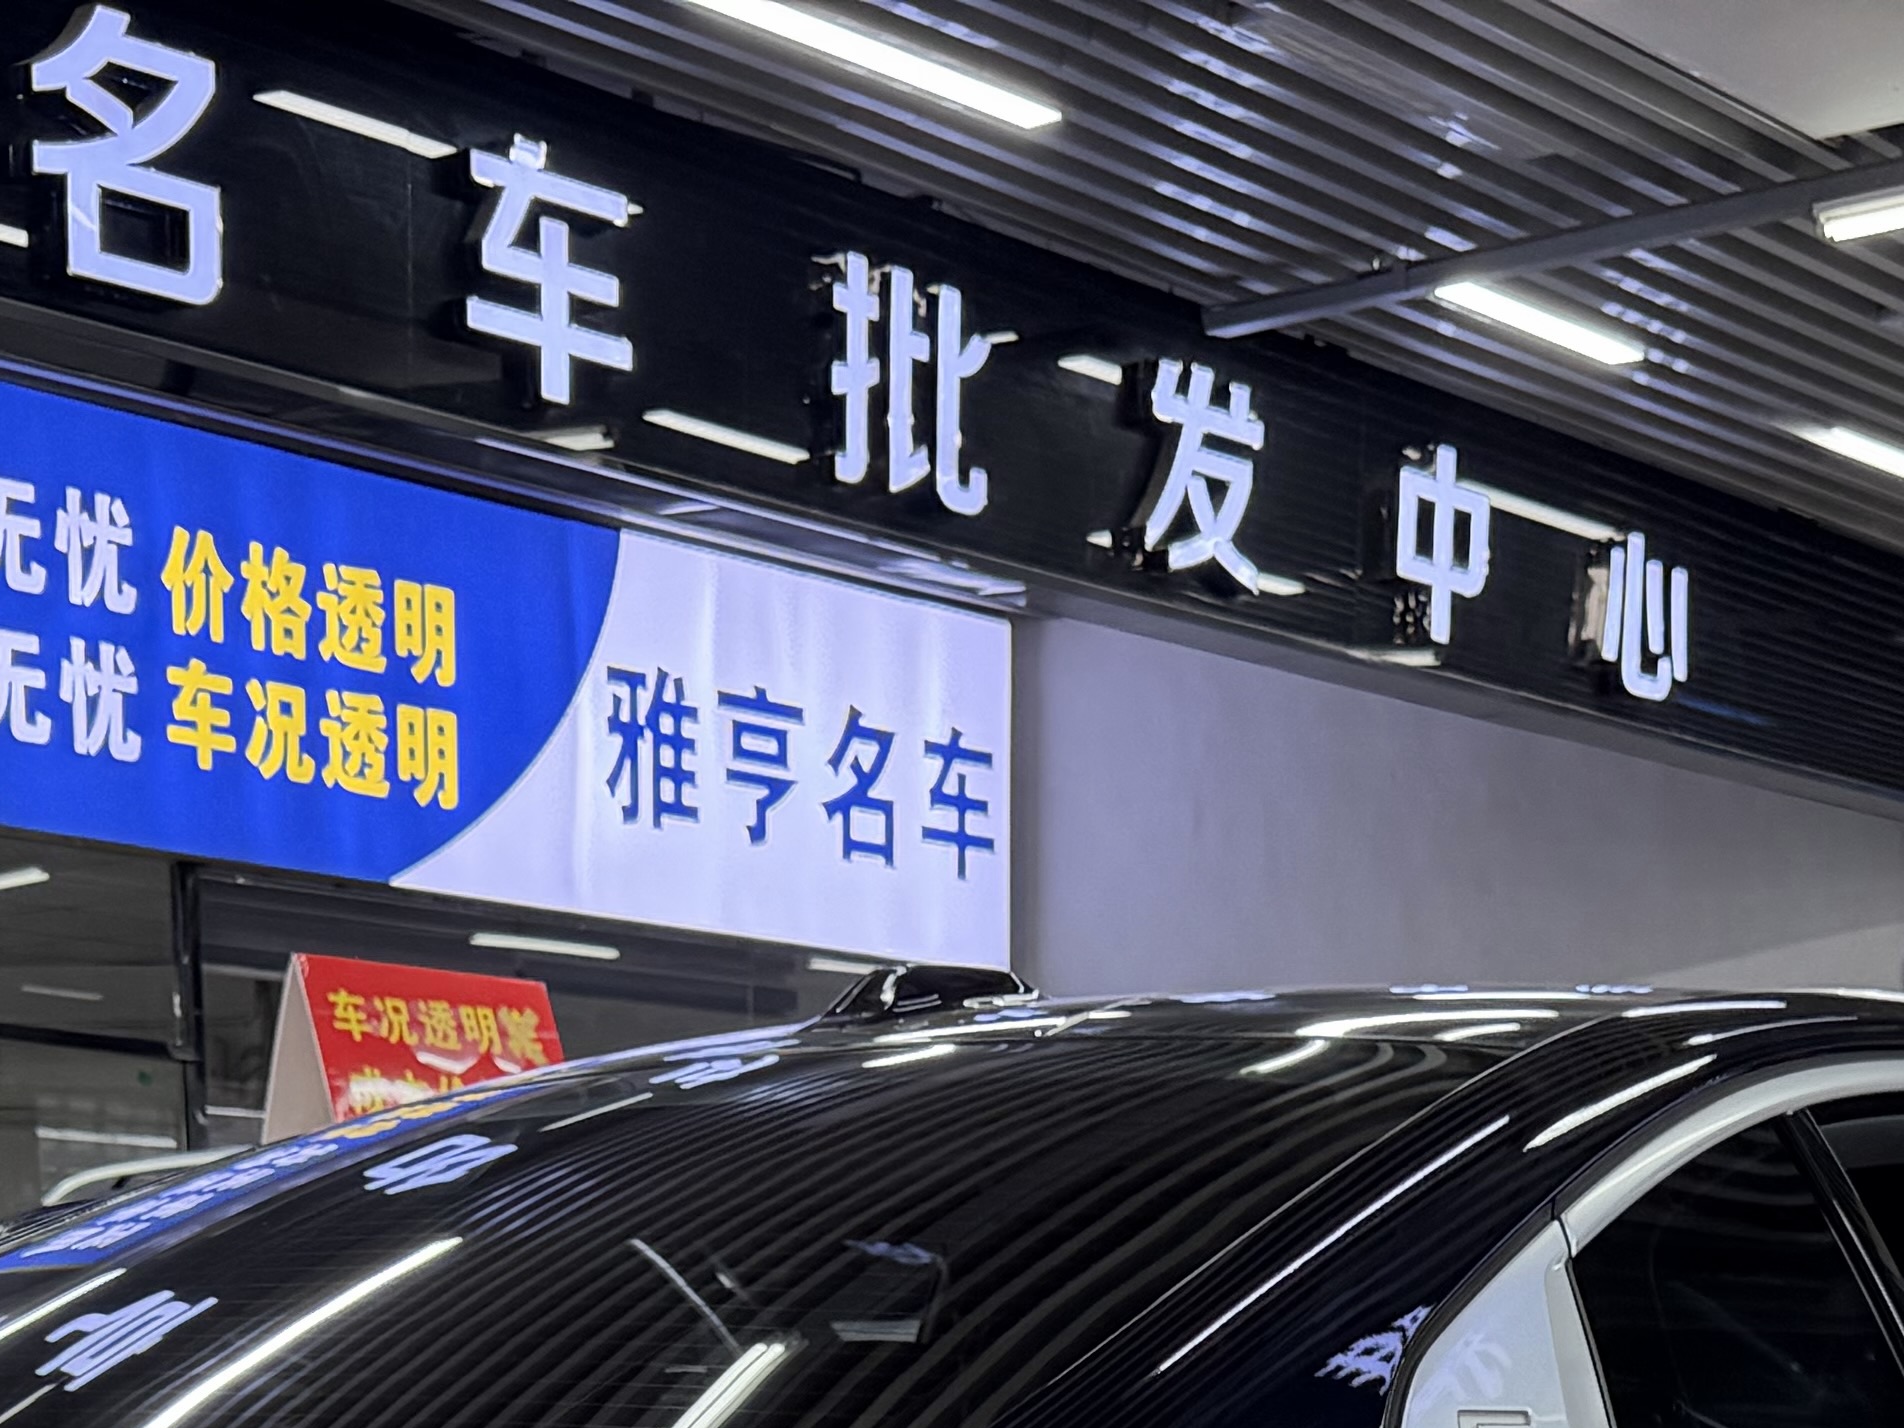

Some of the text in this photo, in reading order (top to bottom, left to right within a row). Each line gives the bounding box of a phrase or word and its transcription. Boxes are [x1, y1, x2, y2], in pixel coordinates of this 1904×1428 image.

[160, 524, 457, 688] 价格透明
[165, 657, 460, 811] 车况透明
[604, 665, 997, 880] 雅亨名车
